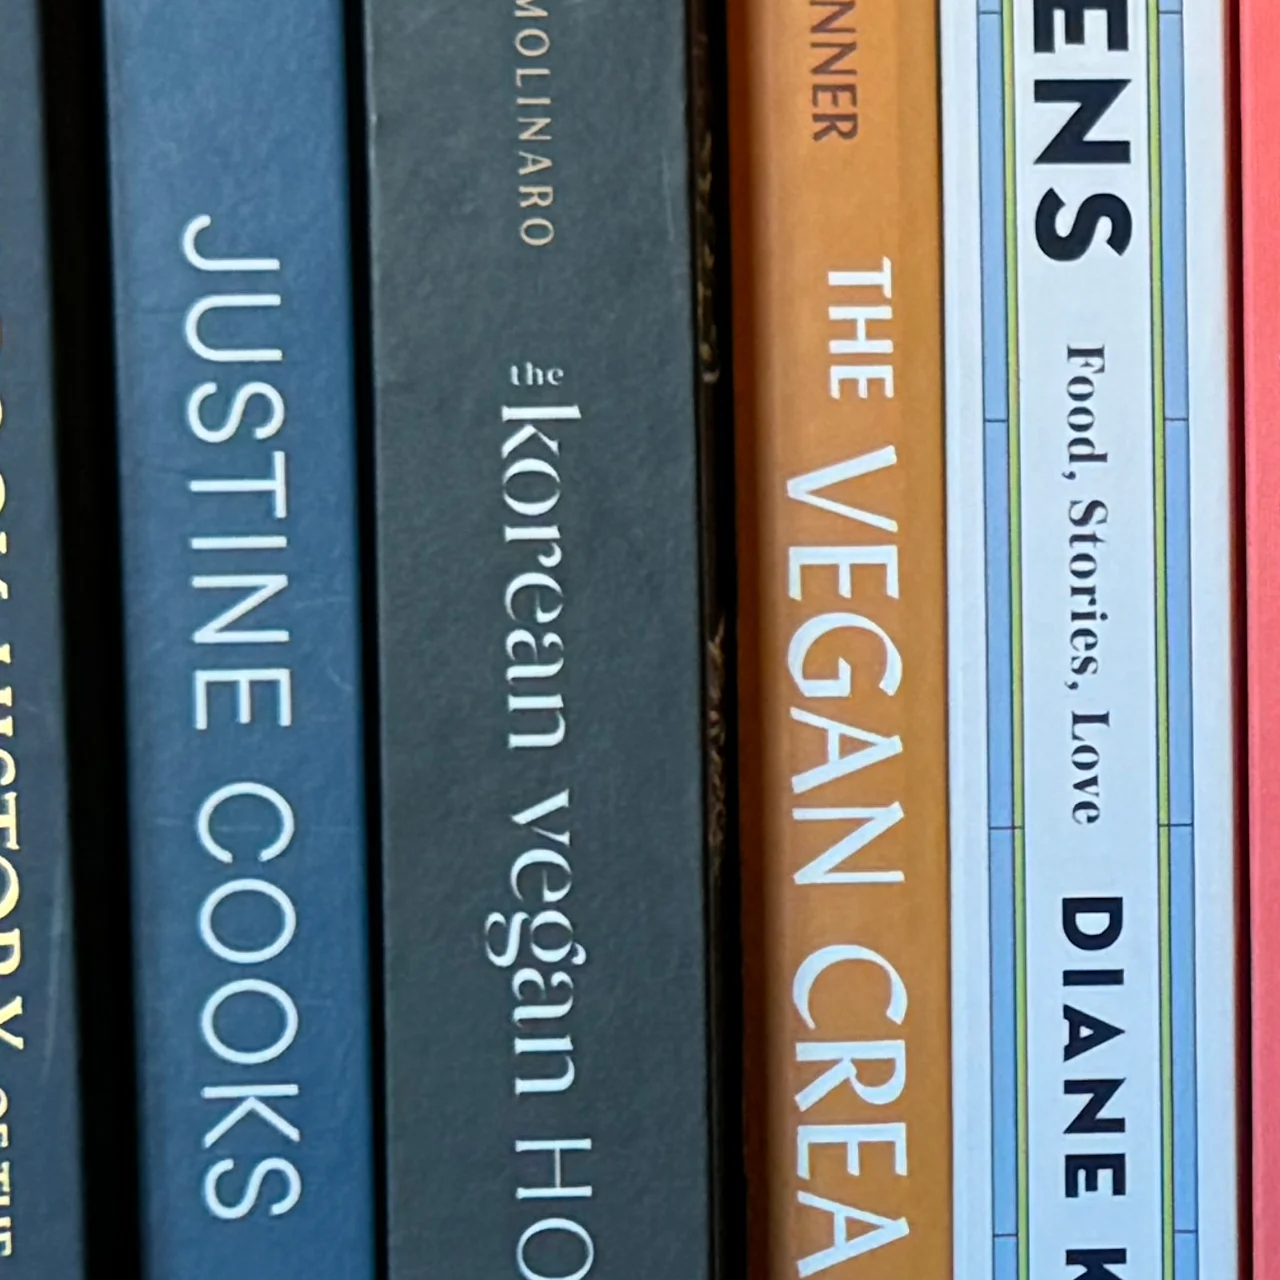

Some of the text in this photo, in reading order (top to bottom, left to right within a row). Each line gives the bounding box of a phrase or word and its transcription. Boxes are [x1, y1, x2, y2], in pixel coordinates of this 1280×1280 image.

[509, 362, 564, 386] the
[827, 256, 894, 401] THE
[181, 214, 303, 1220] JUSTINE COOKS
[500, 404, 583, 751] korean
[786, 445, 905, 886] VEGAN
[1061, 342, 1111, 826] Food, Stories, Love
[485, 788, 585, 1097] vegan
[1061, 895, 1127, 1198] DIANE
